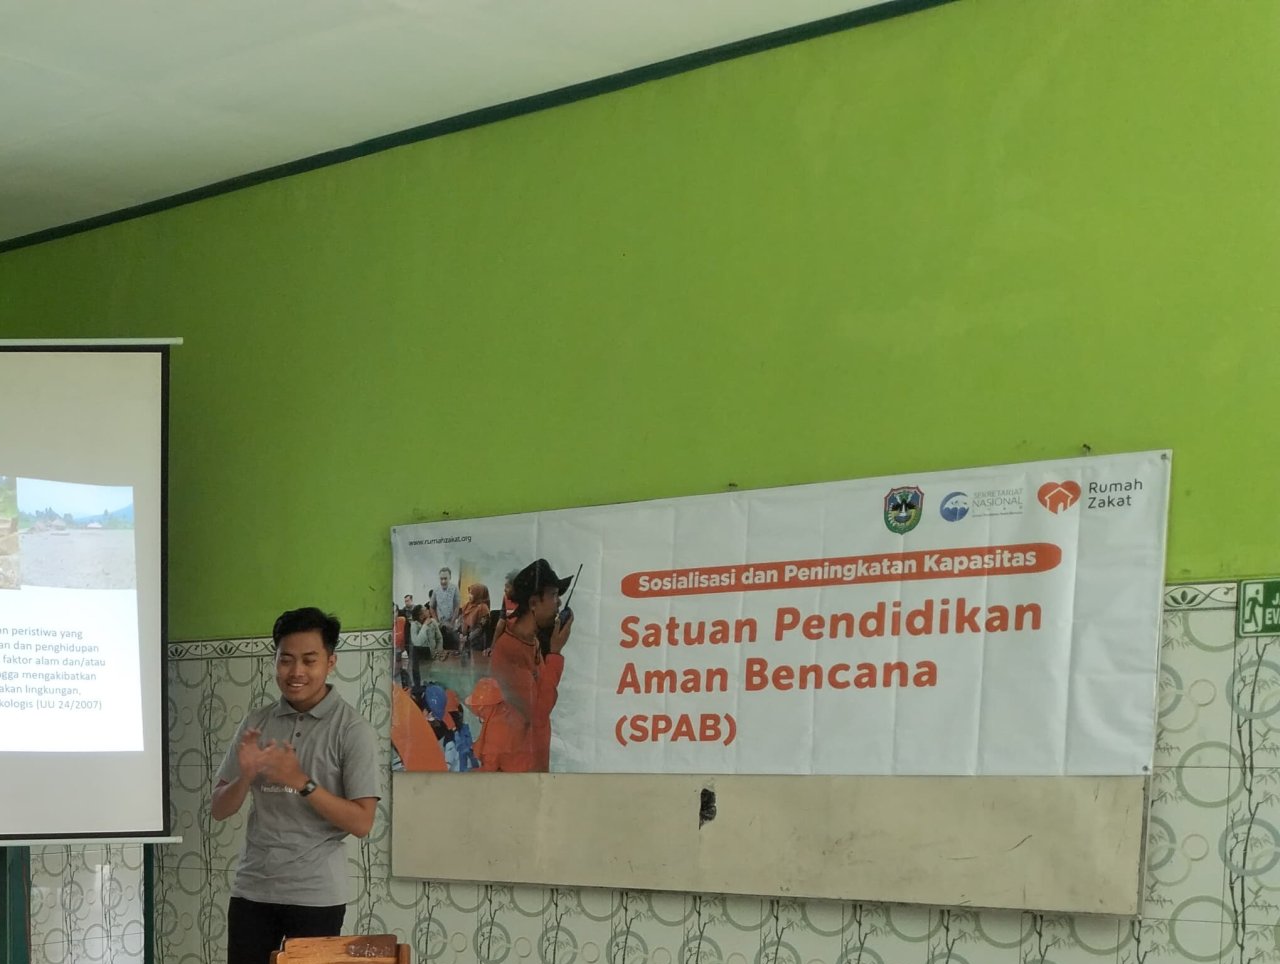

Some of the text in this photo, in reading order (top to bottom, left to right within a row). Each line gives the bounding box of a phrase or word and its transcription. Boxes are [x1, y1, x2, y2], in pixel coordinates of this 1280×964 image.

[1088, 478, 1143, 494] Rumah
[972, 496, 1023, 507] NASIONAL
[1087, 496, 1132, 509] Zakat
[638, 549, 1037, 592] Sosialisasi dan Peningkatan Kapasitas
[1265, 607, 1280, 625] EV
[619, 598, 1042, 649] Satuan Pendidikan
[12, 627, 57, 637] peristiwa
[60, 630, 83, 640] yang
[13, 641, 32, 651] dan
[35, 642, 99, 654] penghidupan
[3, 654, 32, 665] faktor
[35, 656, 60, 666] alam
[62, 657, 106, 668] dan/atau
[22, 671, 97, 681] mengakibatkan
[615, 657, 938, 695] Aman Bencana
[36, 699, 55, 711] (UU
[58, 700, 102, 711] 24/2007)
[615, 712, 737, 747] (SPAB)
